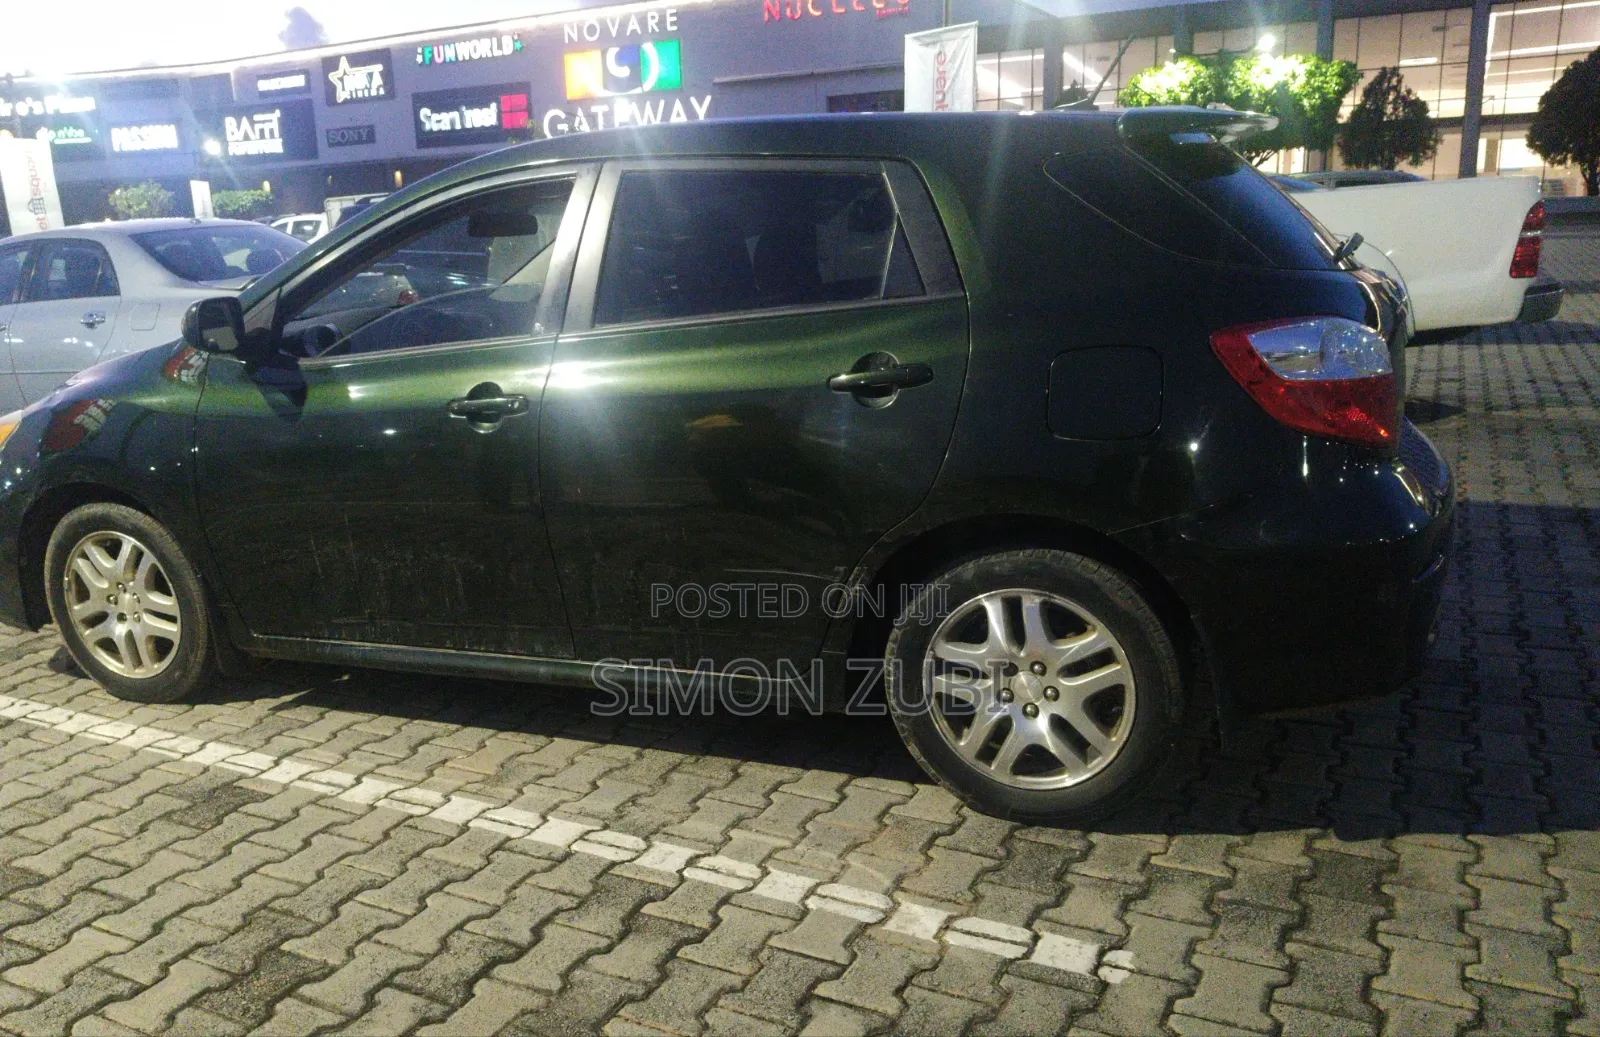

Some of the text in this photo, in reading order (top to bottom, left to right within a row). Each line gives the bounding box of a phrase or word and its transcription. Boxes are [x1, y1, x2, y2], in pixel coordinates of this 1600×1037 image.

[563, 9, 678, 44] NOVARE
[423, 35, 514, 66] FUNWORLD
[543, 95, 712, 139] GATEWAY
[329, 127, 370, 143] SONY
